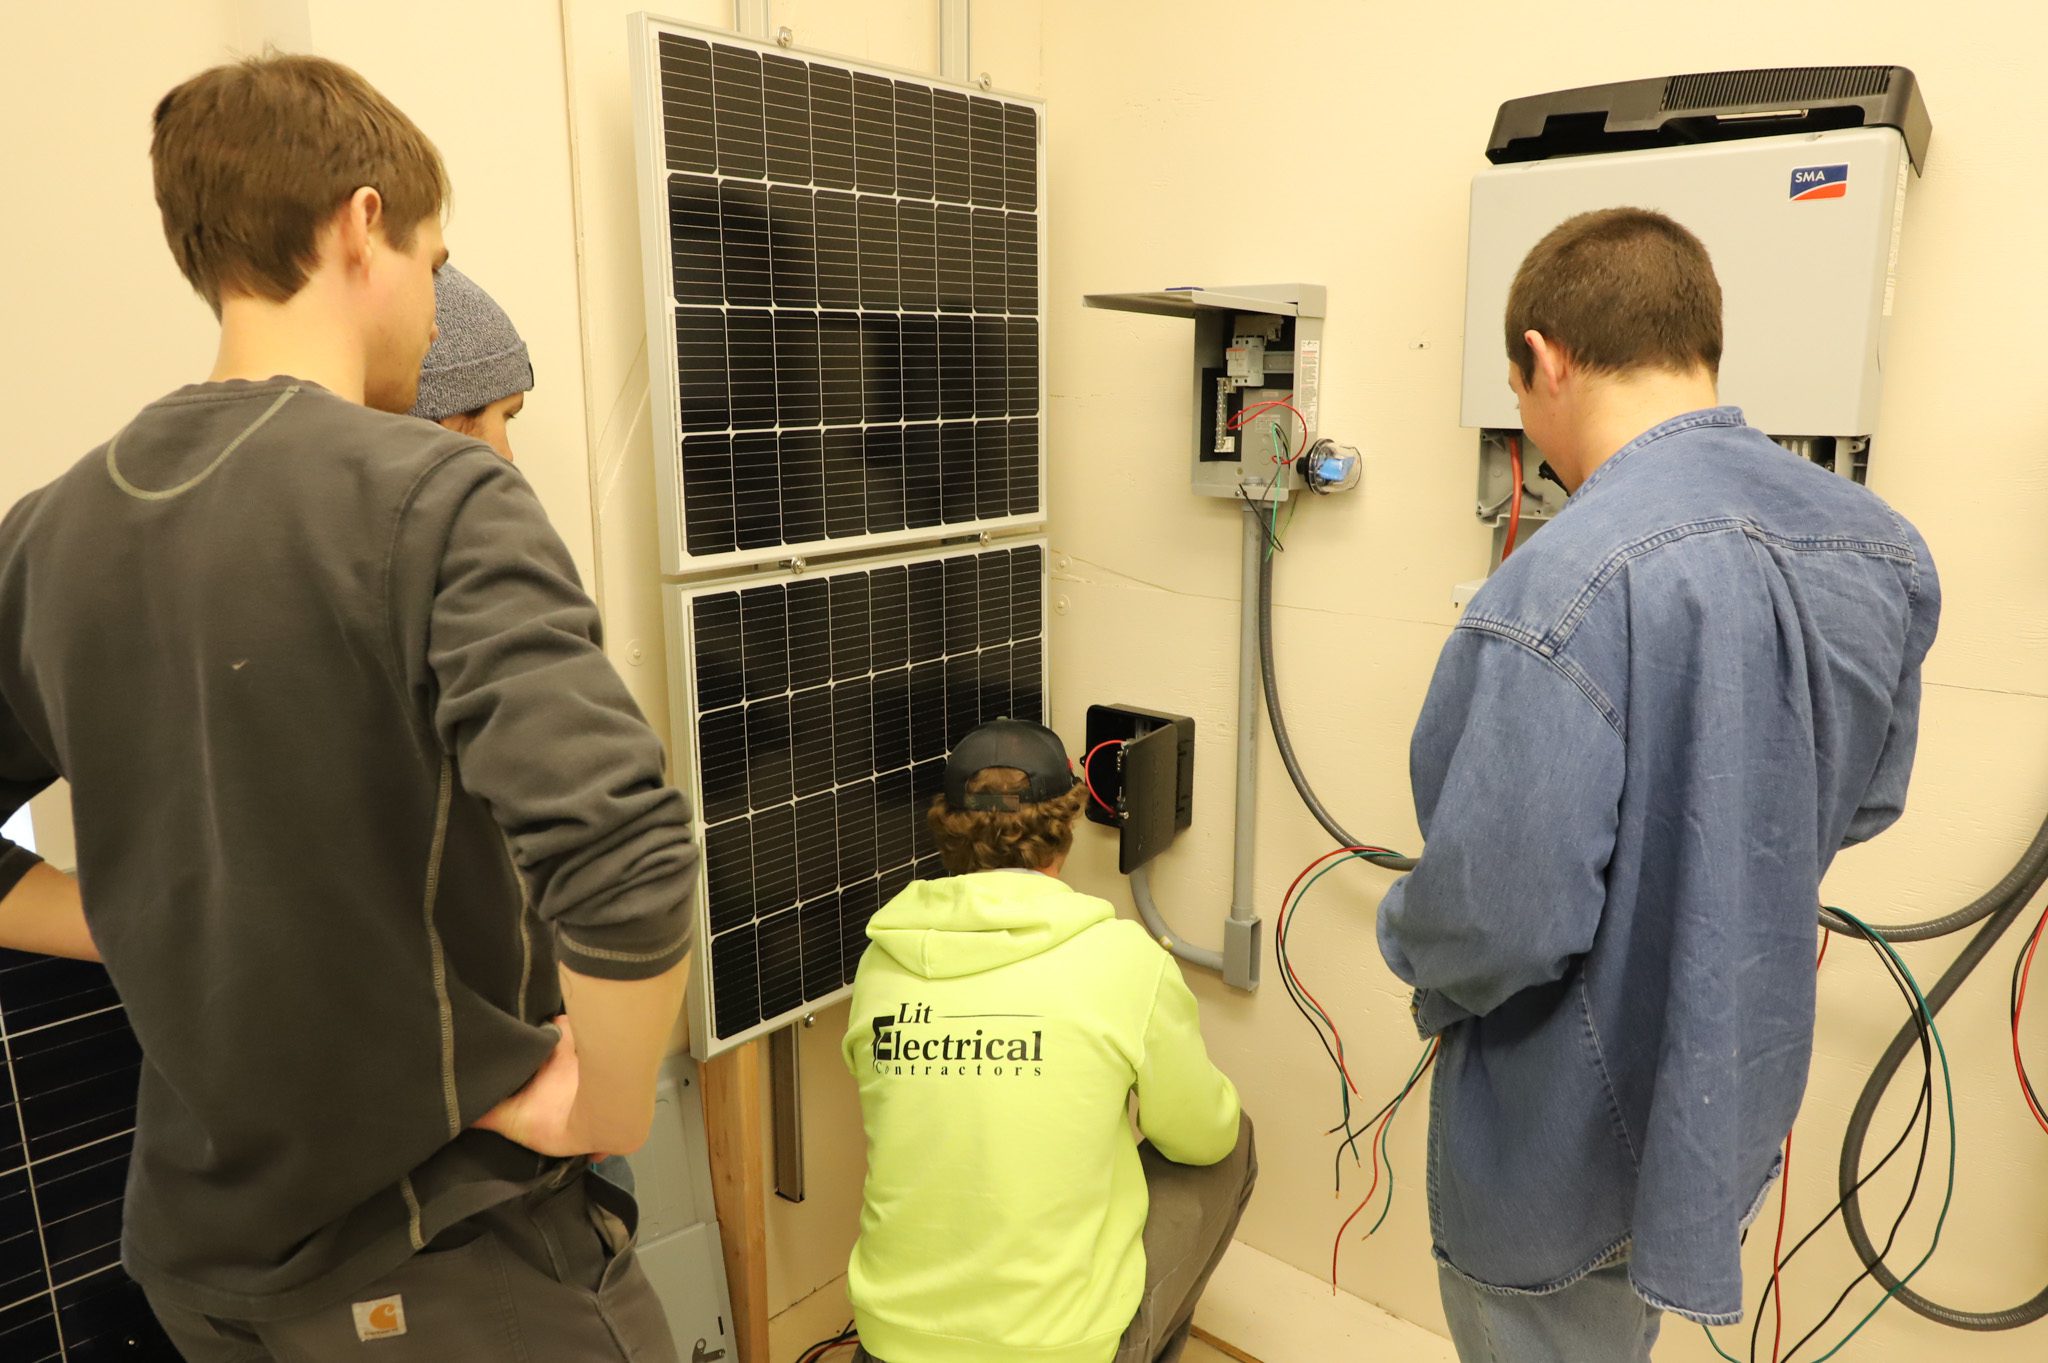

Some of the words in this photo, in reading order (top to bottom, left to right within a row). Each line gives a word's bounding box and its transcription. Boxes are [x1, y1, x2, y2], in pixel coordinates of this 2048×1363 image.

[1795, 170, 1826, 183] SMA
[897, 1002, 934, 1024] Lit
[872, 1015, 1043, 1063] Electrical
[875, 1061, 1042, 1077] Contractors
